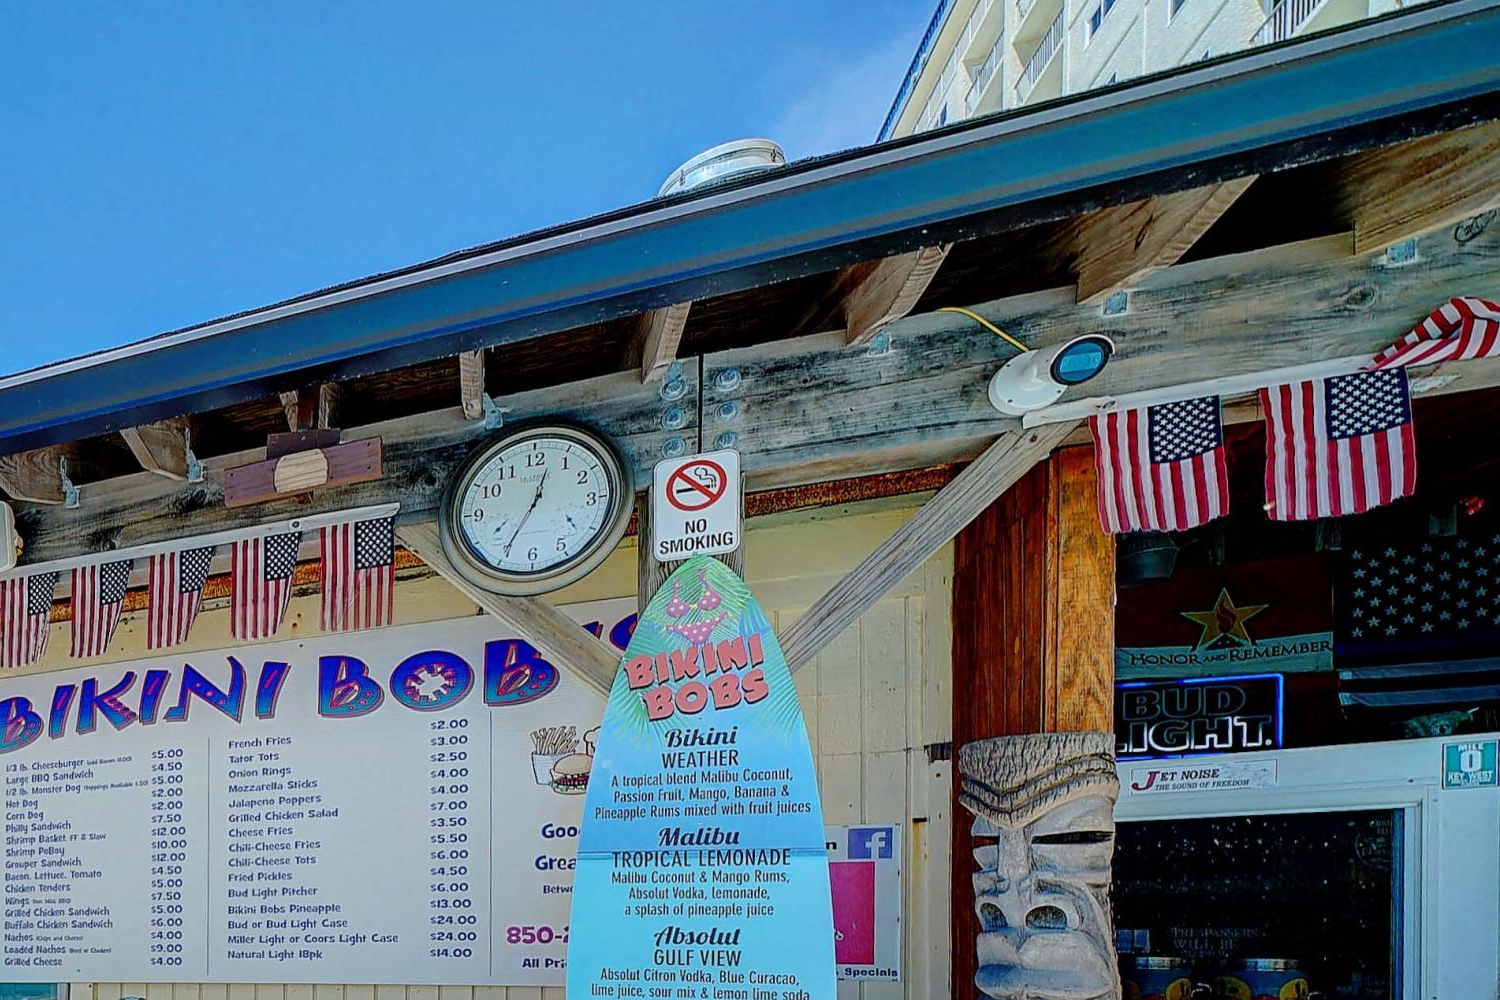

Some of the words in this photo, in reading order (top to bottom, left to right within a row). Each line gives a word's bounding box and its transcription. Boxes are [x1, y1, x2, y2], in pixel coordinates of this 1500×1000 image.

[525, 452, 545, 468] 12
[560, 457, 569, 470] 1
[497, 465, 516, 480] 11
[577, 471, 588, 485] 2
[481, 484, 501, 498] 10
[586, 492, 596, 506] 3
[473, 509, 484, 522] 9
[685, 518, 707, 535] NO
[556, 538, 566, 552] 5
[660, 531, 733, 555] SMOKING
[527, 547, 538, 561] 6
[624, 632, 764, 690] BIKINI
[1130, 651, 1200, 666] HONOR
[1203, 654, 1226, 663] AND
[1229, 640, 1333, 662] REMEMBER
[642, 669, 769, 722] BOBS
[1123, 685, 1246, 720] BUD
[228, 738, 262, 749] French
[266, 736, 292, 746] Fries
[430, 718, 468, 730] $2.00
[665, 726, 738, 748] Bikini
[1115, 715, 1272, 753] IGHT.
[662, 749, 739, 769] WEATHER
[6, 775, 29, 787] Large
[31, 774, 50, 784] BBQ
[53, 769, 94, 781] Sandwich
[151, 762, 183, 772] $4.50
[611, 775, 619, 787] A
[622, 773, 663, 789] tropical
[667, 771, 697, 785] blend
[701, 769, 739, 784] Malibu
[743, 767, 793, 783] Coconut,
[1131, 770, 1178, 792] JET
[1181, 768, 1220, 780] NOISE
[1468, 770, 1493, 783] WEST
[1155, 783, 1170, 791] THE
[1172, 782, 1198, 790] SOUND
[1211, 779, 1250, 788] FREEDOM
[6, 801, 20, 809] Hot
[22, 800, 38, 810] Dog
[151, 787, 183, 797] $2.00
[228, 812, 261, 824] Grilled
[265, 810, 304, 821] Chicken
[308, 808, 339, 818] Salad
[430, 800, 468, 812] $7.00
[5, 824, 29, 834] Philly
[31, 821, 71, 832] Sandwich
[151, 814, 182, 824] $7.50
[541, 823, 580, 839] Goo
[659, 827, 740, 847] Malibu
[5, 860, 37, 870] Grouper
[41, 858, 82, 868] Sandwich
[151, 852, 186, 862] $12.00
[535, 855, 577, 870] Grea
[612, 850, 691, 868] TROPICAL
[699, 848, 791, 867] LEMONADE
[5, 883, 36, 894] Chicken
[39, 882, 71, 892] Tenders
[151, 878, 183, 888] $5.00
[543, 884, 574, 894] Betw
[506, 926, 570, 944] 850-
[654, 926, 741, 946] Absolut
[227, 949, 265, 960] Natural
[268, 949, 294, 961] Light
[299, 950, 323, 961] 18pk
[430, 948, 472, 958] $14.00
[522, 958, 539, 969] All
[545, 957, 568, 969] Pri
[654, 949, 694, 966] GULF
[700, 949, 742, 967] VIEW
[844, 967, 898, 978] Specials
